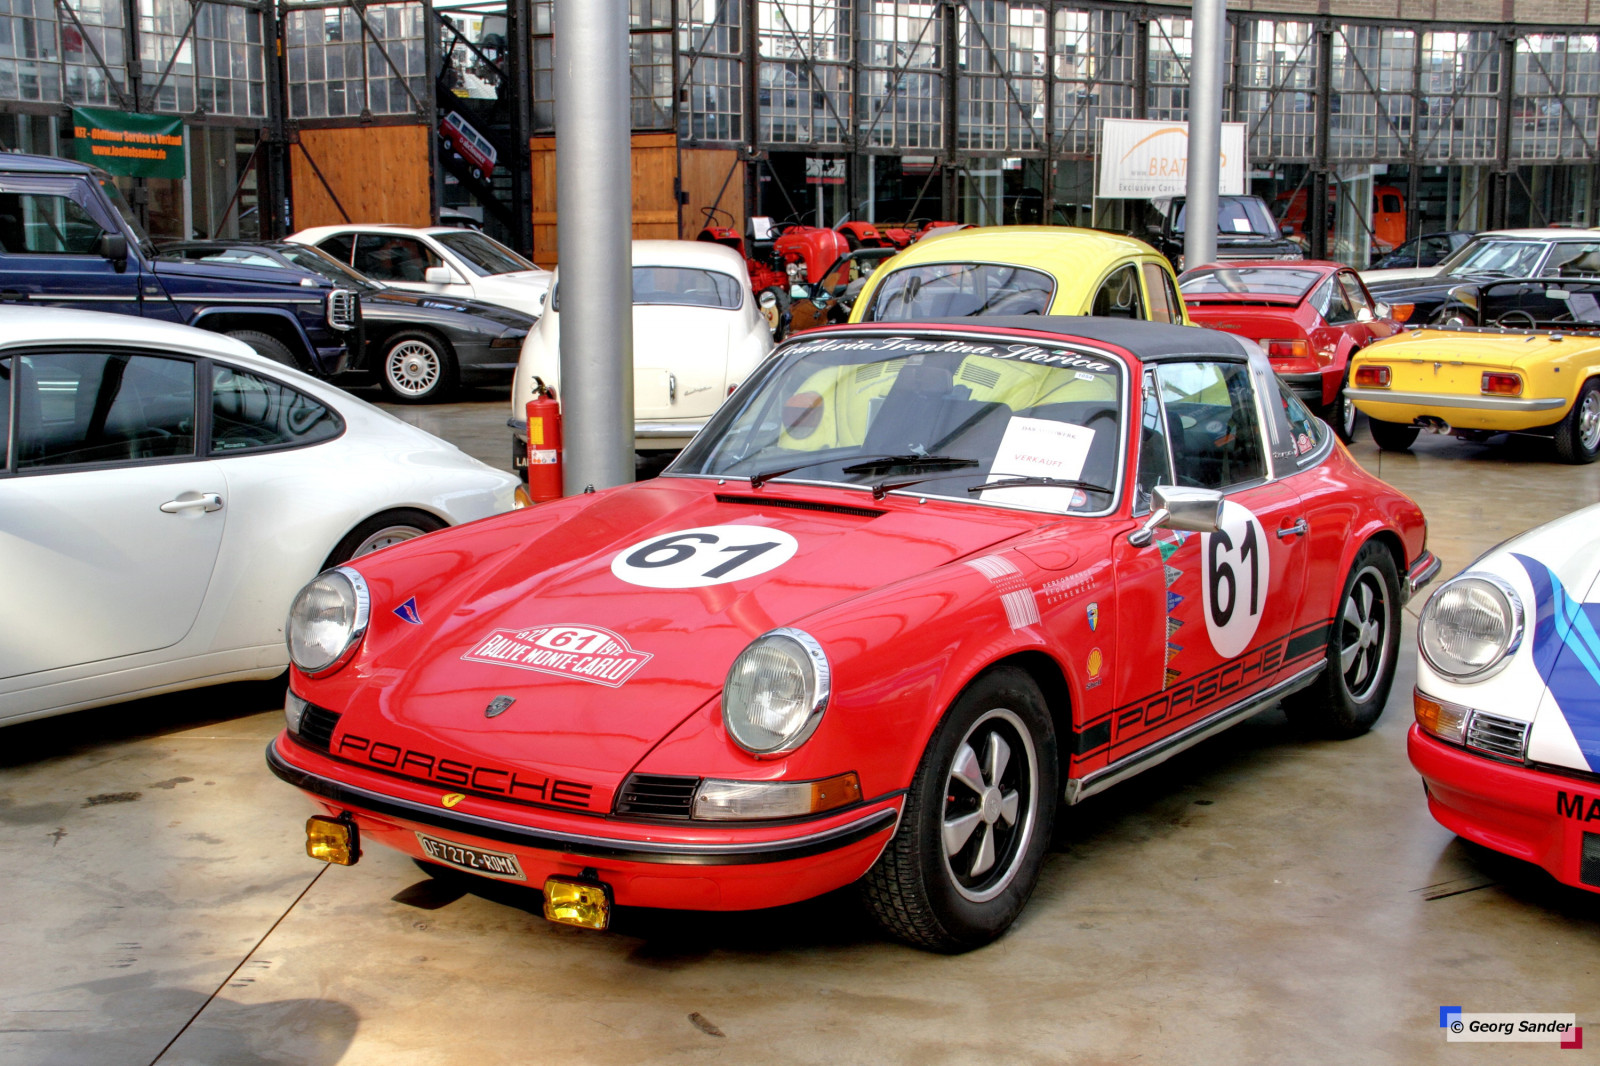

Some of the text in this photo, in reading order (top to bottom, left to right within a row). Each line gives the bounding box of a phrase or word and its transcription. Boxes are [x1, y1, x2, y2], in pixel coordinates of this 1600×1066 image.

[91, 128, 123, 141] Oldtimer
[123, 131, 150, 144] Service
[151, 135, 156, 144] &
[157, 134, 182, 146] Verkauf
[1148, 157, 1188, 177] BRAT
[1119, 183, 1156, 192] Exclusive
[1158, 184, 1176, 192] Cars
[871, 336, 995, 355] Trentina
[992, 344, 1111, 372] Storica
[1014, 453, 1063, 468] VERKAUFT
[625, 533, 783, 579] 61
[1208, 519, 1259, 628] 61
[474, 634, 637, 680] RALLYE MONTE-CARLO
[549, 631, 598, 651] 61
[1115, 642, 1283, 741] PORSCHE
[338, 733, 593, 808] PORSCHE
